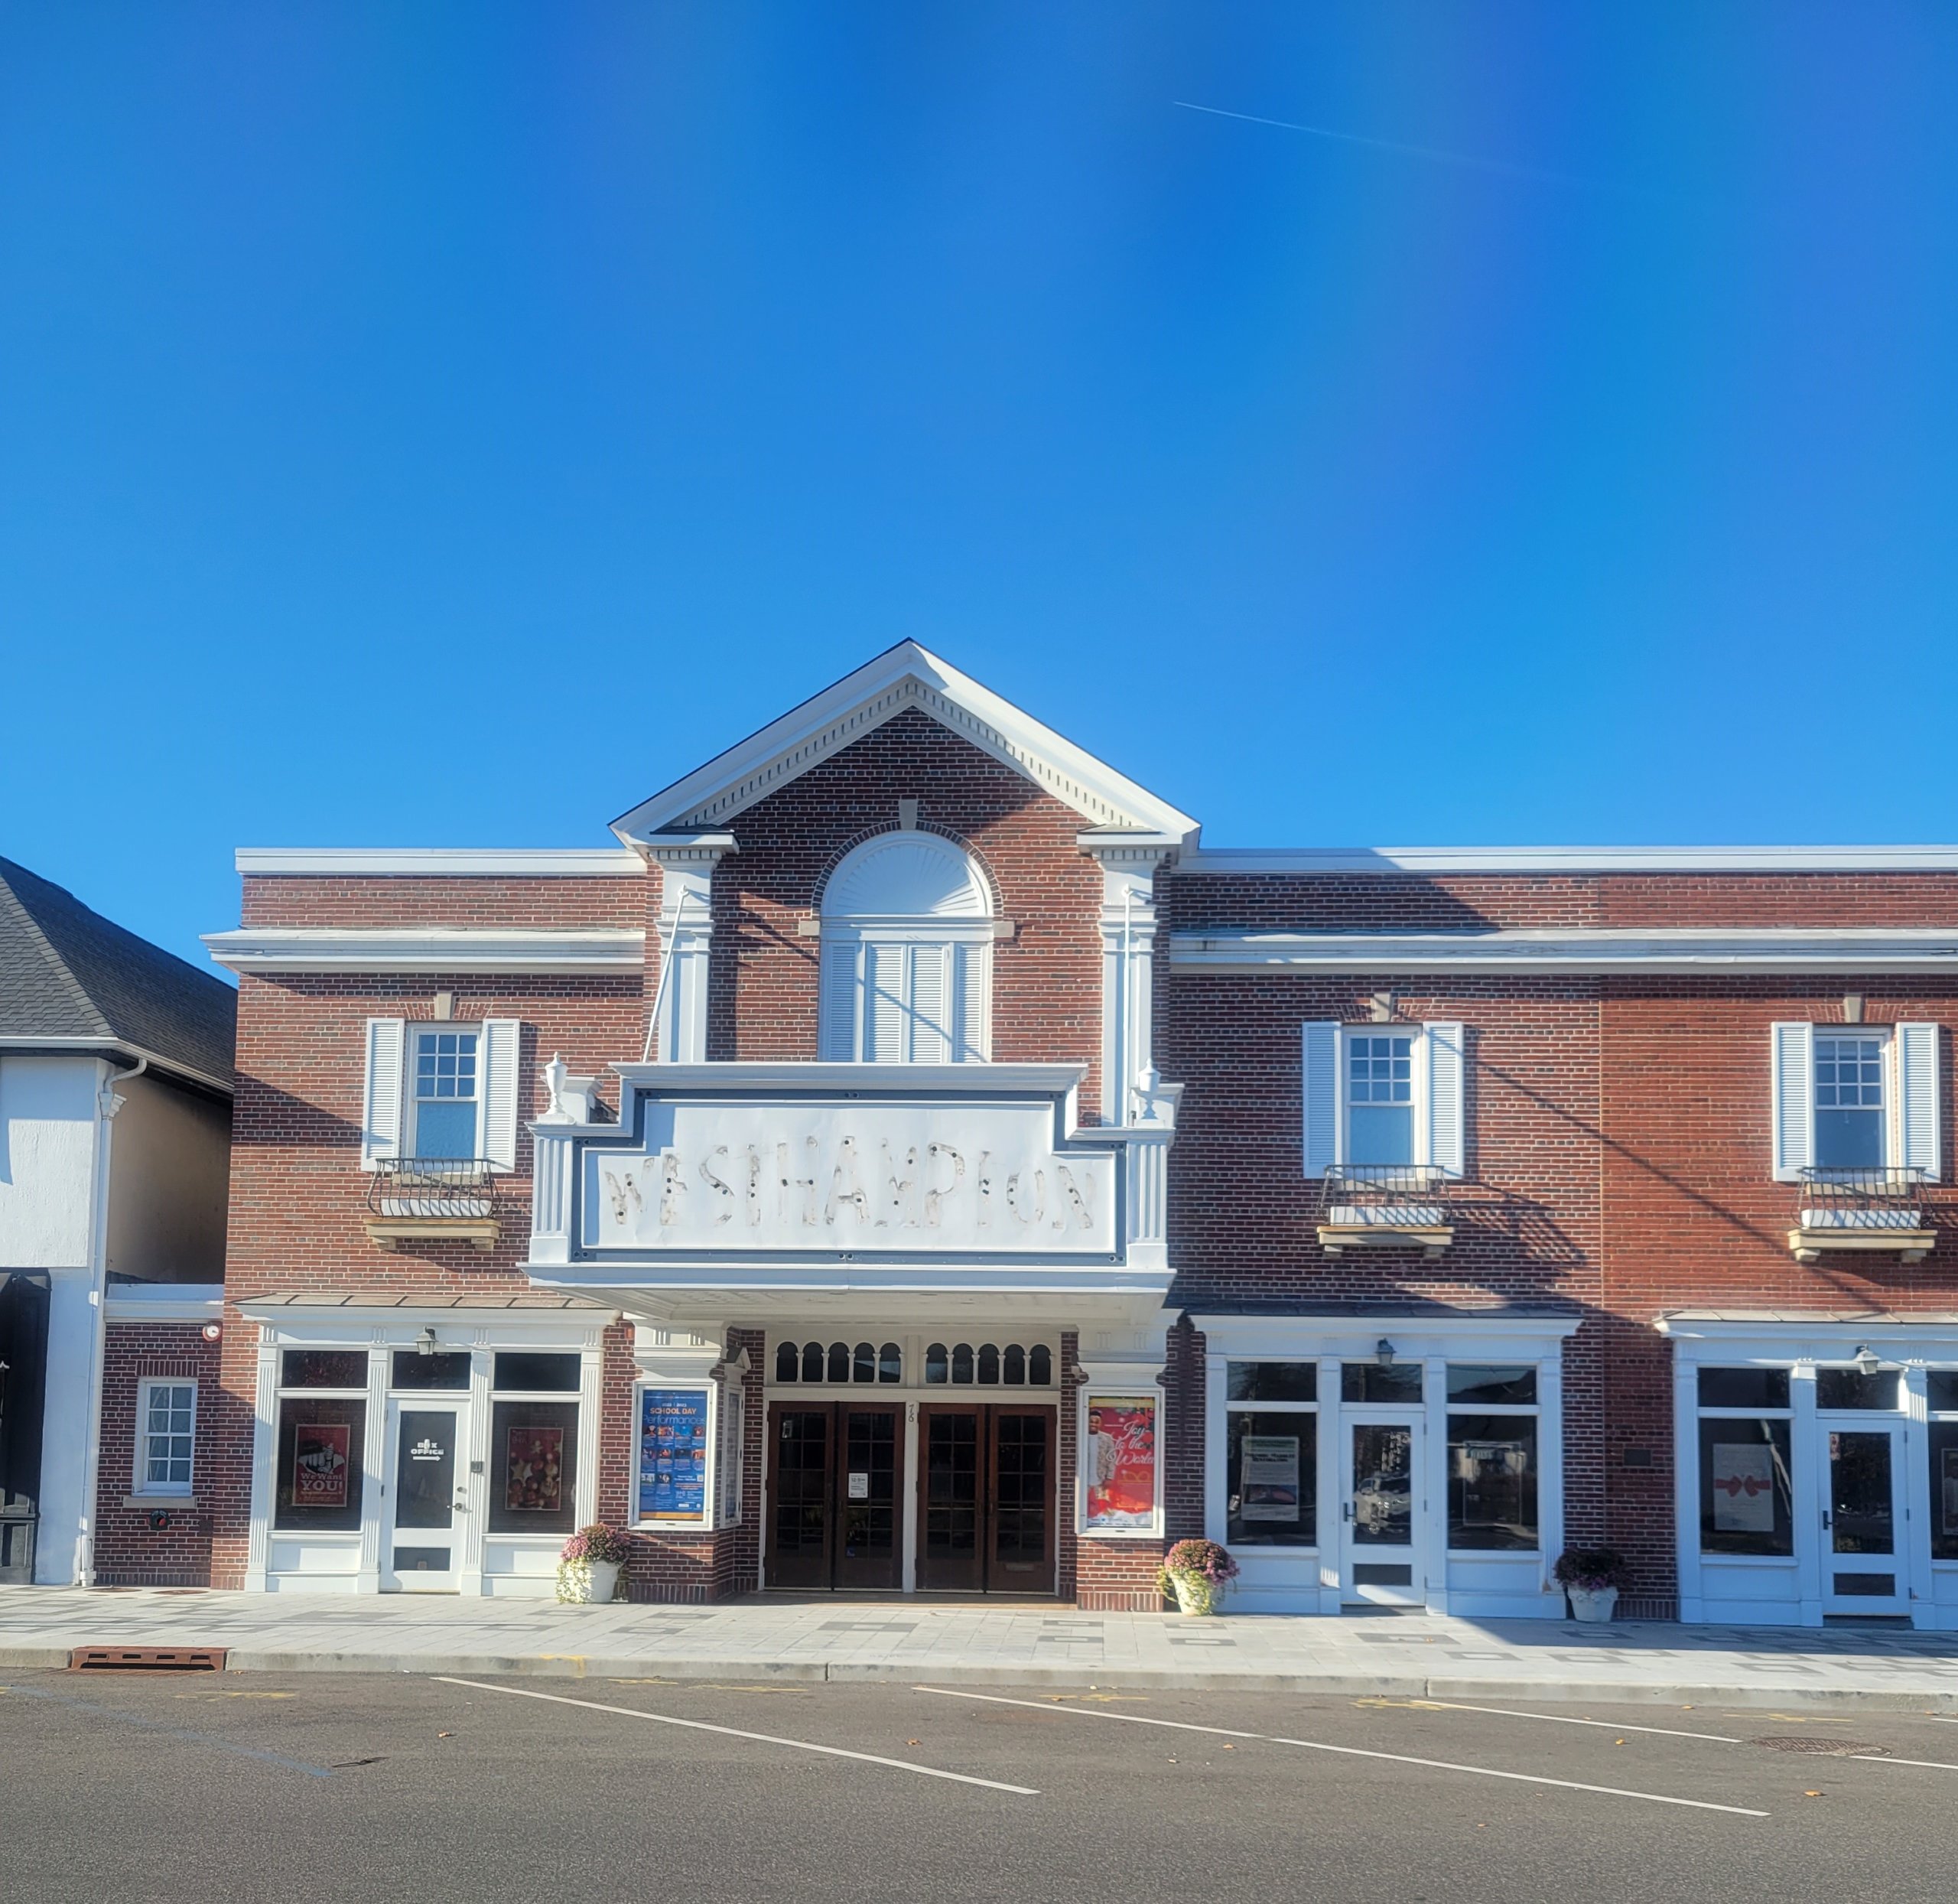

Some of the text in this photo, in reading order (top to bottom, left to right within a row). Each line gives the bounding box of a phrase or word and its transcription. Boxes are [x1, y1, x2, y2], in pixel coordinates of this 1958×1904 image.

[642, 1414, 705, 1424] Performances
[1122, 1420, 1146, 1439] Joy
[301, 1480, 343, 1494] YOU!
